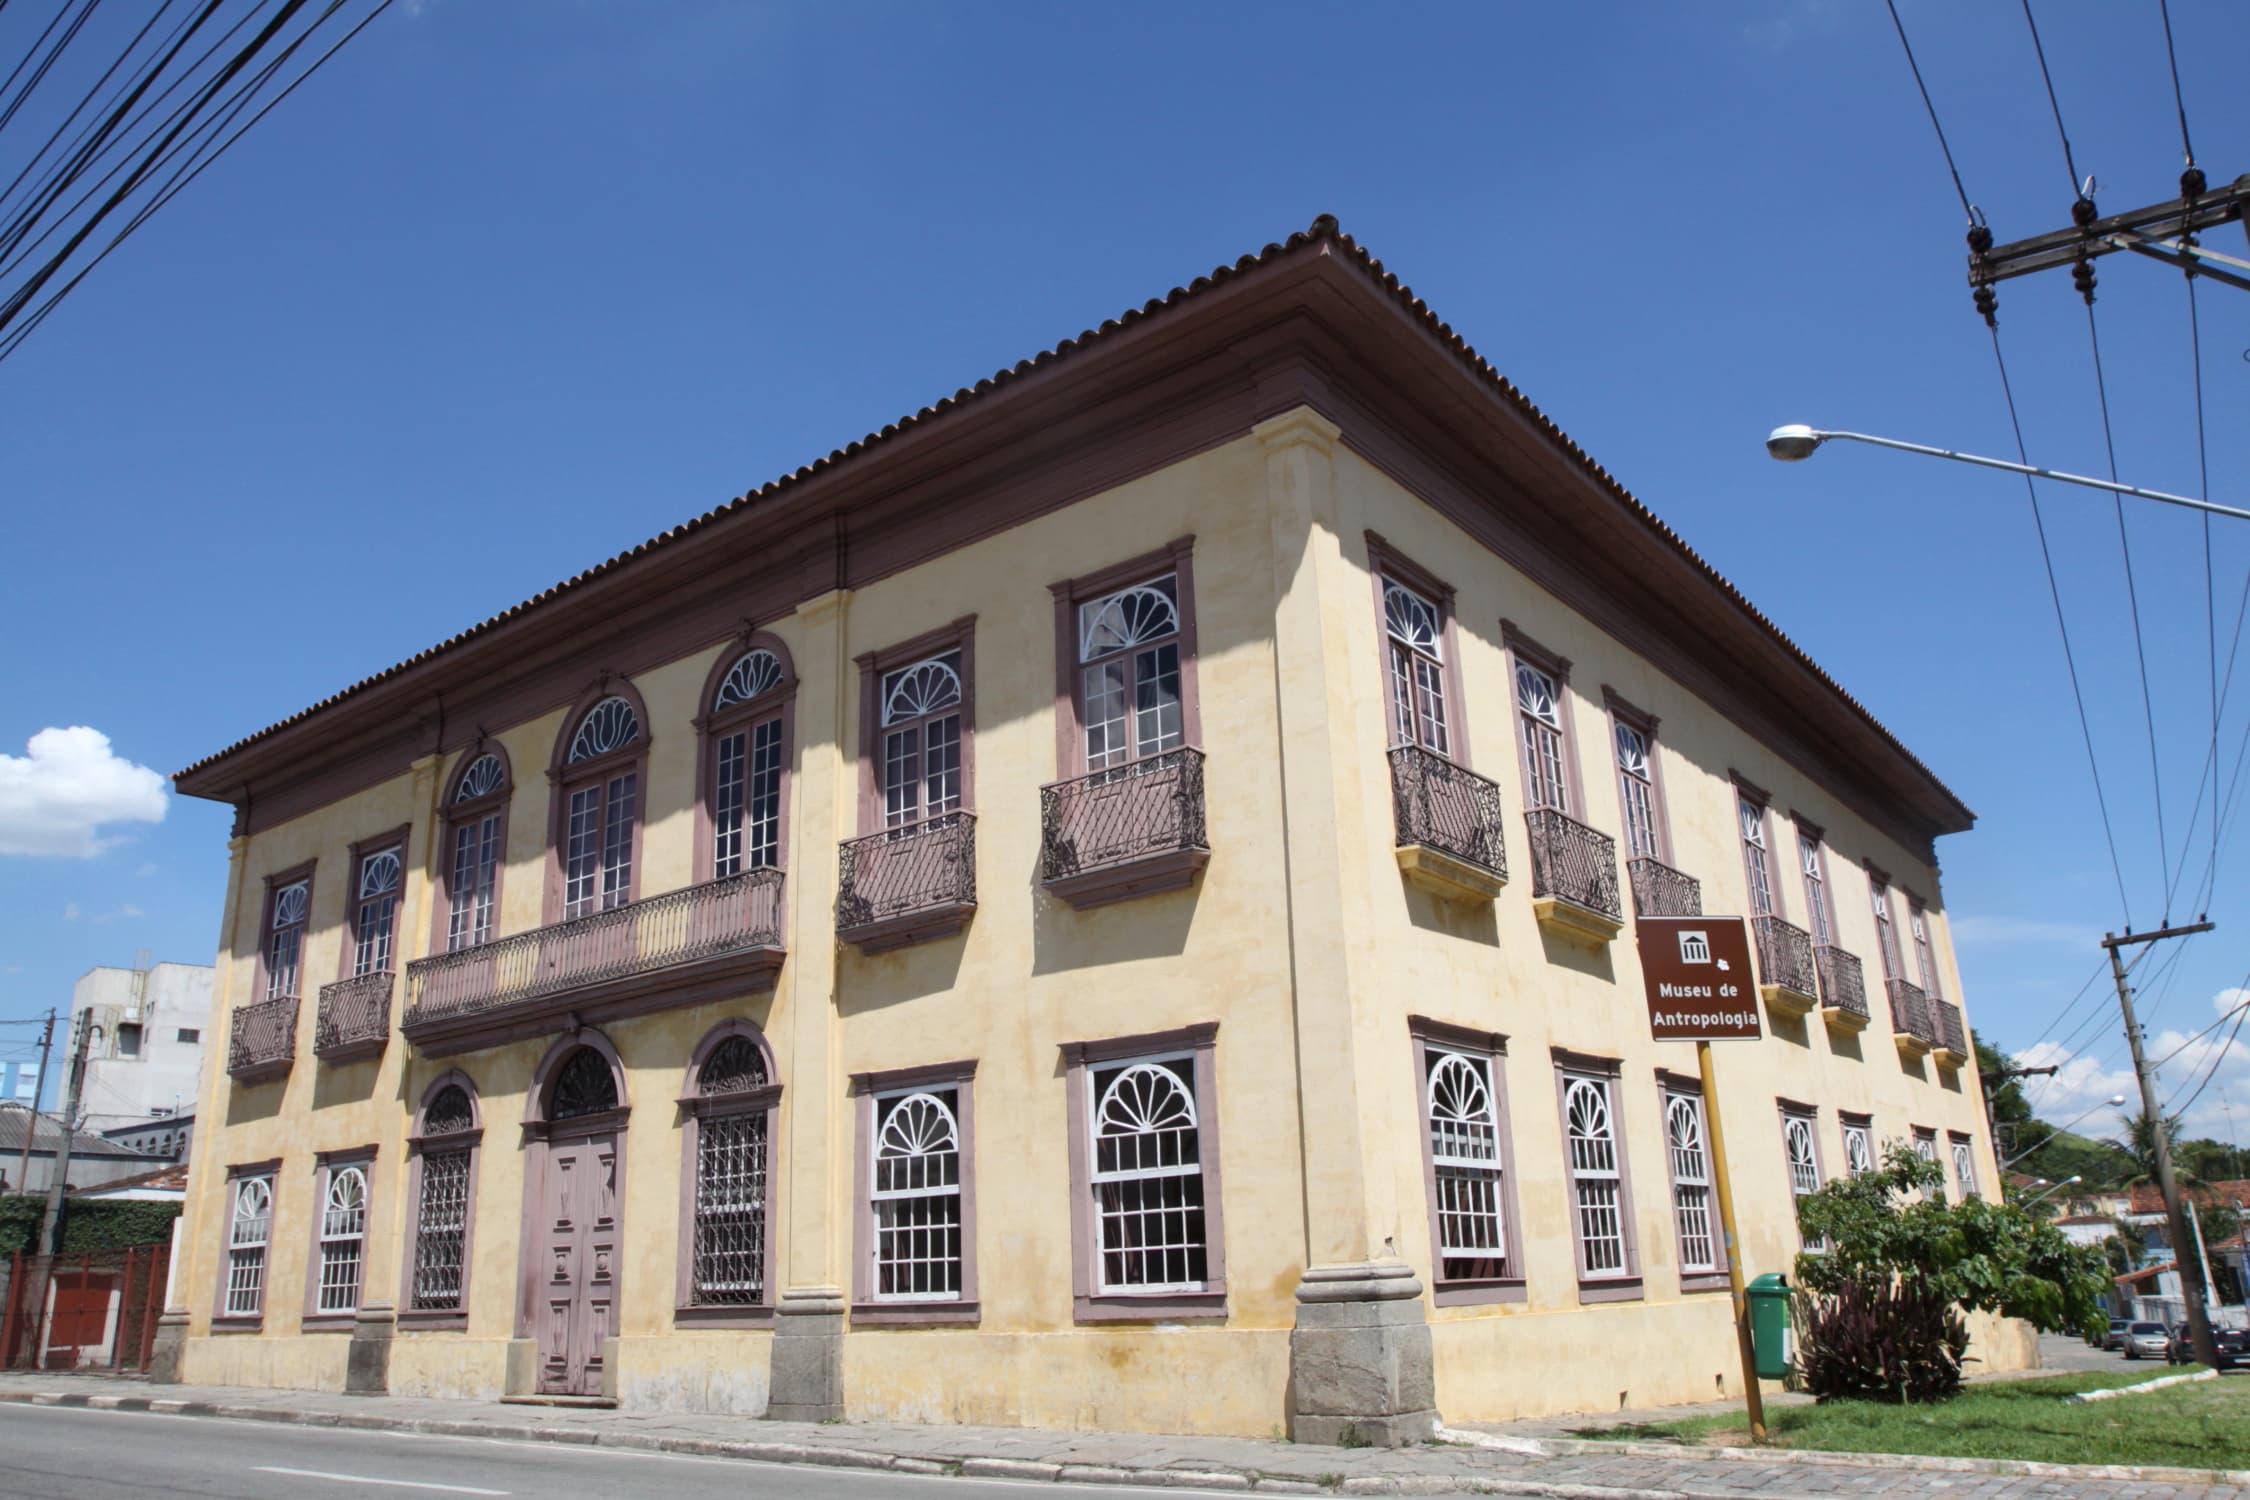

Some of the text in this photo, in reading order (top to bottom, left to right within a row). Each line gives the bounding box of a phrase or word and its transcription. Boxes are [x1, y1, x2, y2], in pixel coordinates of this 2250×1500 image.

[1659, 983, 1738, 997] Museu de
[1653, 1010, 1758, 1029] Antropologia
